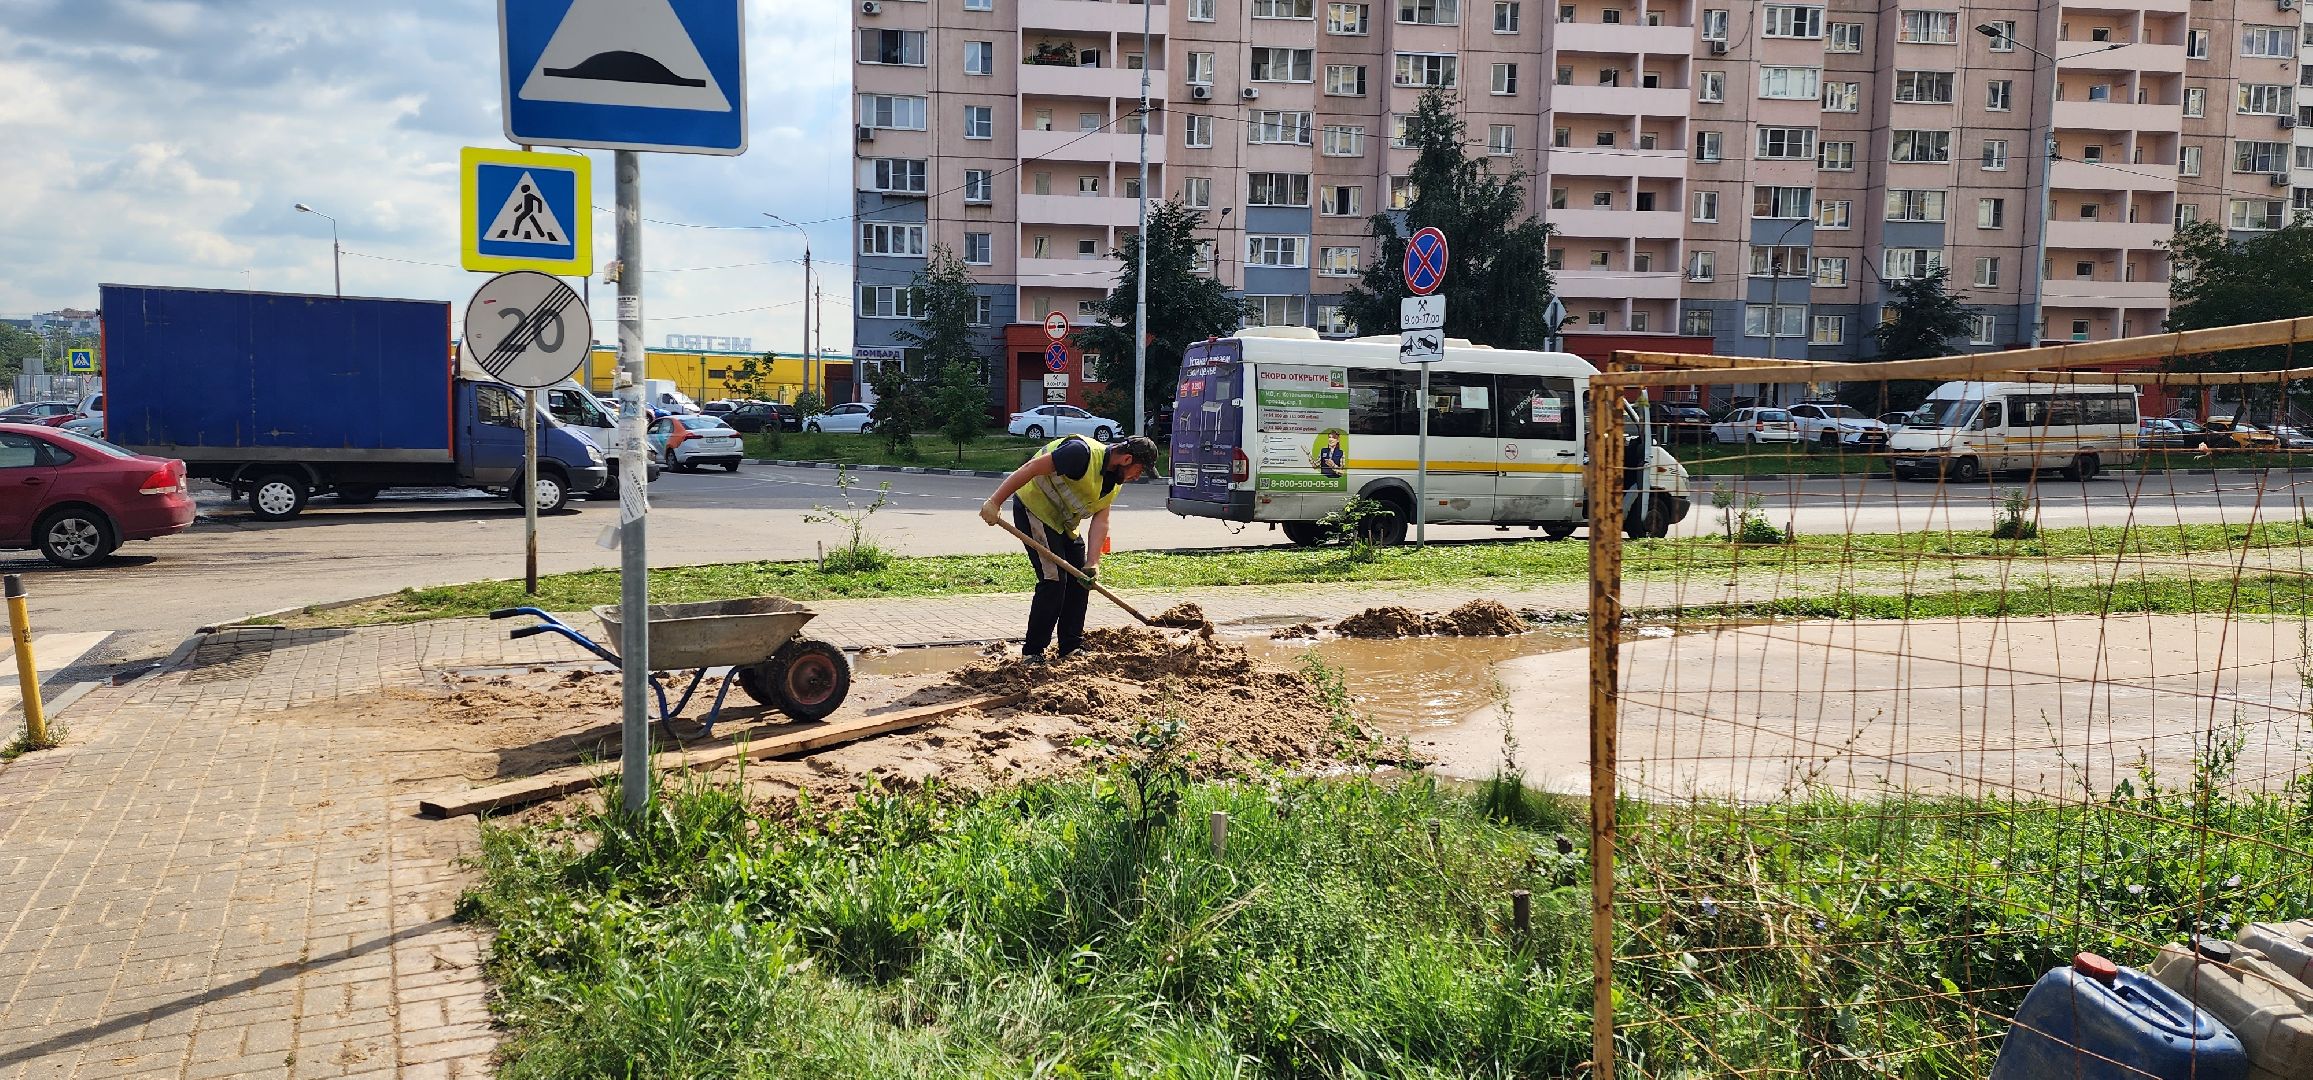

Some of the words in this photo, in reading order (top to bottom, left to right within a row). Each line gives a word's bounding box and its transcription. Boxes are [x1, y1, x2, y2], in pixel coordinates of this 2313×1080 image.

[497, 307, 565, 353] 20
[855, 350, 900, 358] ЛОМБАРД
[1260, 371, 1287, 380] СКОРО
[1289, 373, 1329, 382] ОТКРЫТИЕ
[1270, 480, 1339, 488] 8-800-500-05-58
